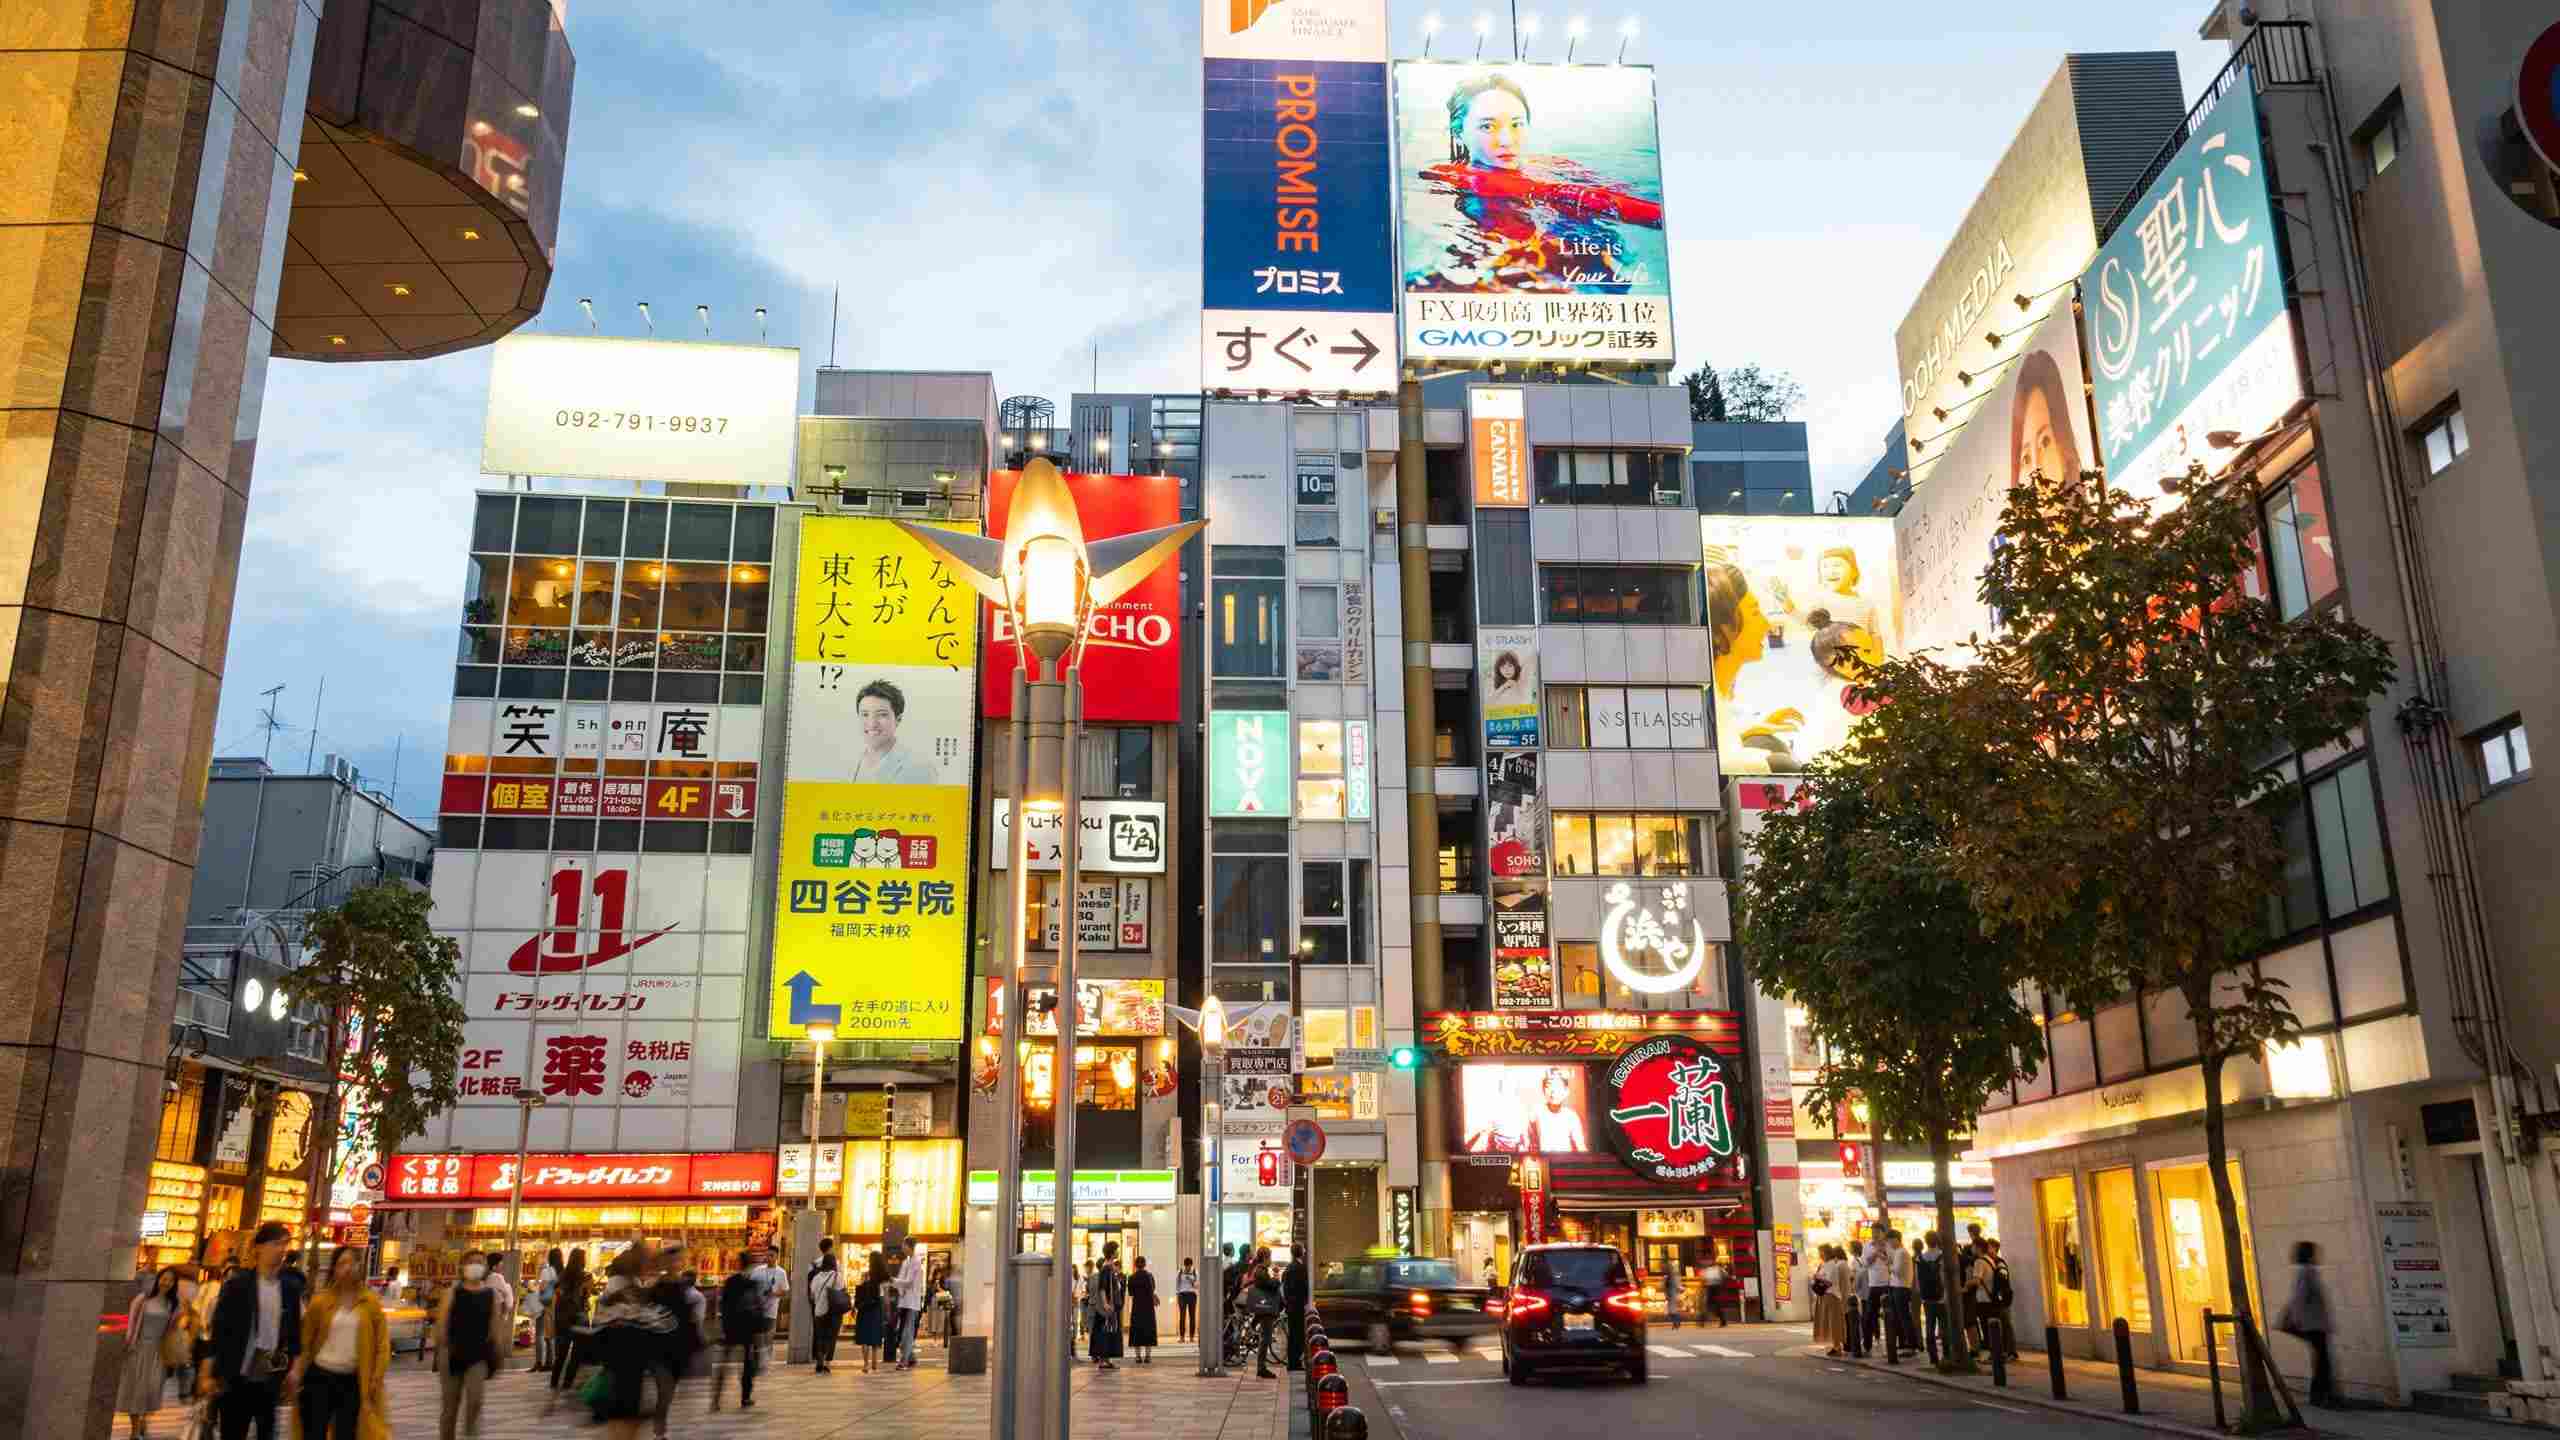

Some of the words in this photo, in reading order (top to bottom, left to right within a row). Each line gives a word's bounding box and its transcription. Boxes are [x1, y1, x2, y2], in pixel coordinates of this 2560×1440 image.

[1275, 73, 1319, 253] PROMISE
[2136, 131, 2251, 334] 聖心
[1558, 238, 1603, 257] Life
[1605, 238, 1623, 257] is
[1253, 267, 1344, 294] プロミス
[1562, 266, 1608, 285] Your
[1544, 301, 1657, 324] 世界第1位
[1418, 329, 1659, 349] GMOクリック証券
[1902, 336, 1944, 418] OOH
[1943, 238, 2016, 354] MEDIA
[1216, 325, 1318, 373] すぐ
[555, 409, 729, 434] 092-791-9937
[1490, 421, 1509, 499] CANARY
[871, 555, 909, 625] 私が
[927, 559, 960, 672] なんで、
[1086, 614, 1172, 647] CHO
[501, 704, 555, 754] 笑
[655, 708, 710, 759] 庵
[1235, 718, 1265, 812] NOVA
[491, 782, 549, 809] 個室
[658, 785, 700, 814] 4F
[1506, 855, 1542, 866] SOHO
[789, 879, 955, 915] 四谷学院
[549, 869, 629, 954] 11
[831, 922, 912, 938] 福岡天神校
[1497, 920, 1545, 934] もつ料理
[1503, 934, 1541, 948] 専門店
[494, 991, 647, 1011] ドラッグイレブン
[850, 1016, 912, 1030] 200m先
[462, 1050, 503, 1070] 2F
[627, 1040, 691, 1061] 免税店
[542, 1035, 608, 1096] 薬
[1611, 1041, 1671, 1088] ICHIRAN
[459, 1076, 522, 1096] 化粧品
[1611, 1056, 1733, 1155] 一蘭
[404, 1158, 461, 1175] くすり
[1232, 1154, 1250, 1165] For
[401, 1177, 460, 1195] 化粧品
[535, 1166, 673, 1186] ドラッグイレブン
